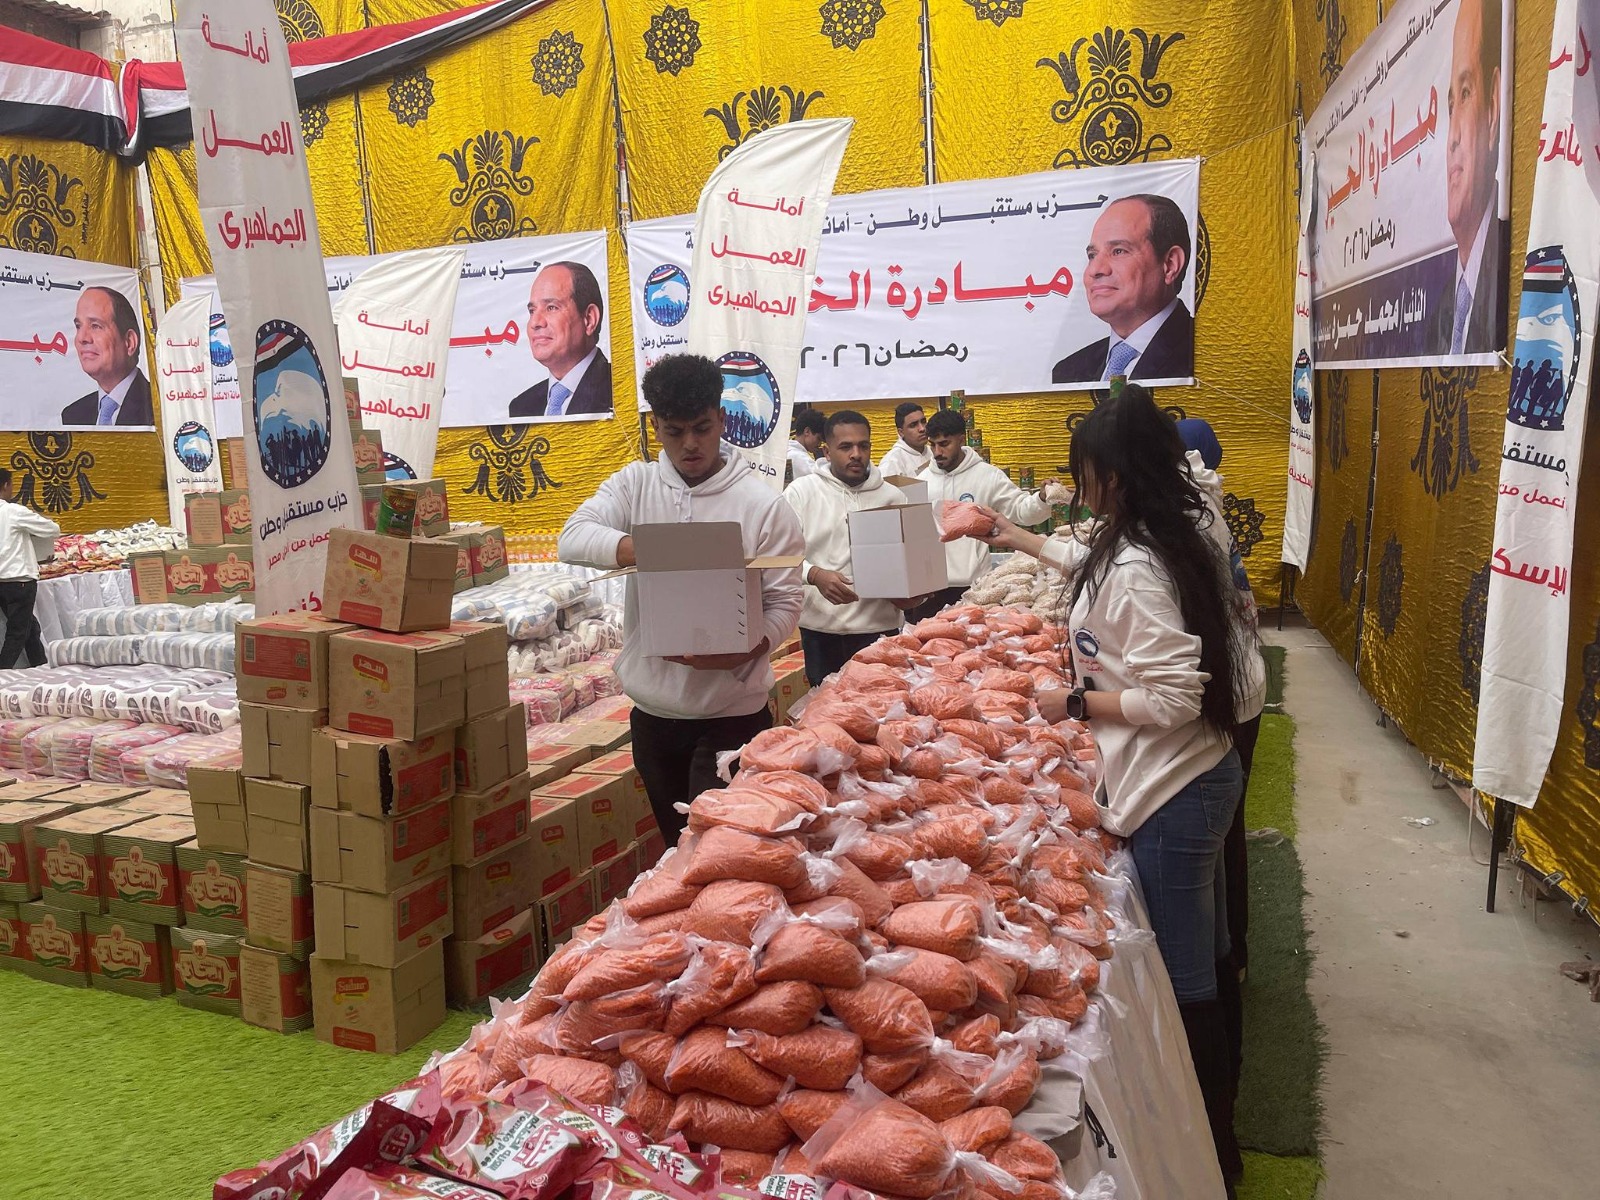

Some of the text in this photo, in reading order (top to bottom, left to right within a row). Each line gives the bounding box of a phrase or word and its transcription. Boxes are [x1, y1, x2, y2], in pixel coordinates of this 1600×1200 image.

[201, 14, 269, 64] أمانة
[202, 109, 294, 158] العمل
[1325, 85, 1438, 232] مبادرة الخير
[727, 188, 805, 216] أمانة
[932, 197, 1033, 231] مستقبل
[1037, 193, 1108, 219] حزب
[821, 212, 851, 236] أمان
[867, 208, 929, 236] وطن
[711, 234, 806, 268] العمل
[1363, 218, 1396, 260] رمضان
[32, 271, 84, 291] حزب
[328, 271, 353, 291] أمان
[490, 260, 541, 280] حزب
[807, 260, 1074, 320] مبادرة الخ
[358, 310, 430, 335] أمانة
[341, 350, 435, 379] العمل
[800, 338, 969, 369] رمضان ٢٠٢٦
[358, 398, 430, 421] الجماهي
[759, 463, 777, 477] حزب
[327, 491, 348, 513] حزب
[1523, 489, 1566, 508] نعمل
[259, 516, 282, 541] وطن
[281, 499, 323, 531] مستقبل
[291, 536, 307, 554] من
[309, 531, 330, 549] عمل
[480, 1110, 532, 1167] Tomato Puree
